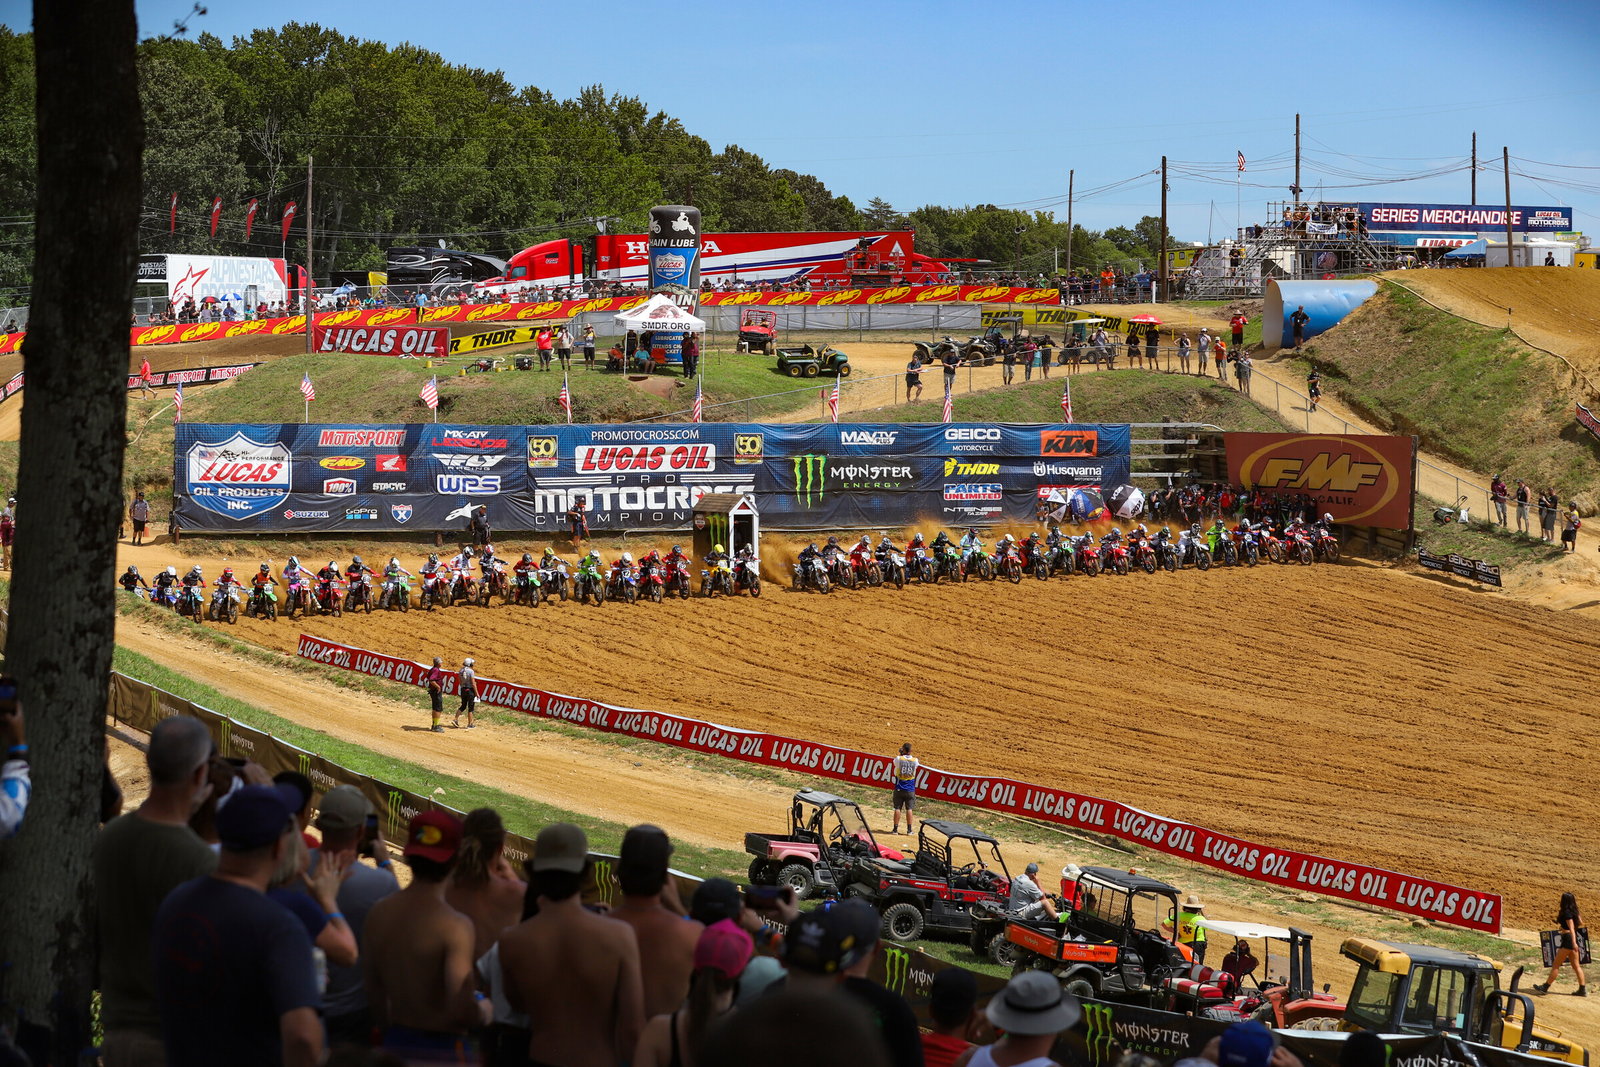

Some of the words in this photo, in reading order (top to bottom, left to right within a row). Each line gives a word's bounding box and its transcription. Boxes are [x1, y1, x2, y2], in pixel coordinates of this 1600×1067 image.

[1371, 208, 1418, 223] SERIES
[1421, 209, 1521, 225] MERCHANDISE
[670, 239, 694, 247] LUBE
[211, 259, 275, 283] ALPINESTARS
[719, 292, 761, 305] FMF
[768, 292, 811, 305] FMF
[817, 290, 861, 305] FMF
[867, 287, 911, 304] FMF
[916, 285, 959, 302] FMF
[965, 287, 1010, 302] FMF
[1015, 289, 1057, 304] FMF
[467, 304, 511, 320] FMF
[517, 302, 562, 319] FMF
[568, 298, 612, 316] FMF
[319, 310, 361, 326] FMF
[367, 308, 411, 325] FMF
[1037, 310, 1078, 323] THOR
[181, 322, 220, 341] FMF
[226, 319, 267, 337] FMF
[642, 321, 690, 330] SMDR.ORG
[137, 325, 176, 344] FMF
[321, 328, 397, 353] LUCAS
[401, 329, 438, 354] OIL
[472, 329, 516, 348] THOR
[445, 429, 488, 438] MX-ATV
[591, 430, 699, 441] PROMOTOCROSS.COM
[945, 428, 1002, 440] GEICO
[531, 438, 555, 457] 50
[737, 435, 761, 454] 50
[1043, 435, 1095, 453] KTM
[320, 457, 365, 469] FMF
[581, 447, 666, 471] LUCAS
[670, 446, 710, 469] OIL
[199, 462, 282, 482] LUCAS
[831, 464, 913, 480] MONSTER
[957, 463, 1000, 475] THOR
[1047, 465, 1102, 476] Husqvarna
[1258, 452, 1383, 492] FMF
[328, 483, 352, 493] 100%
[373, 482, 406, 491] STACYC
[438, 475, 500, 495] WPS
[617, 475, 675, 484] PRO
[194, 487, 214, 496] OIL
[218, 487, 284, 497] PRODUCTS
[944, 484, 1002, 493] PARTS
[227, 501, 253, 510] INC.
[1318, 494, 1356, 506] CALIF.
[294, 510, 329, 518] SUZUKI
[535, 512, 684, 525] CHMPION
[297, 639, 335, 664] LUCAS
[333, 649, 351, 669] OIL
[355, 653, 394, 679] LUCAS
[395, 663, 414, 684] OIL
[480, 684, 523, 708] LUCAS
[522, 692, 541, 713] OIL
[546, 698, 588, 723] LUCAS
[589, 705, 610, 727] OIL
[613, 712, 660, 737] LUCAS
[661, 718, 684, 742] OIL
[230, 733, 255, 752] MONSTER
[689, 725, 739, 753] LUCAS
[739, 736, 764, 758] OIL
[770, 740, 821, 769] LUCAS
[822, 751, 847, 774] OIL
[310, 767, 336, 788] MONSTER
[936, 775, 990, 802] LUCAS
[990, 782, 1017, 806] OIL
[1023, 789, 1075, 820] LUCAS
[1078, 800, 1105, 826] OIL
[1112, 808, 1169, 844] LUCAS
[1167, 826, 1197, 854] OIL
[1201, 836, 1261, 872] LUCAS
[1261, 852, 1292, 879] OIL
[1296, 859, 1358, 893] LUCAS
[1359, 872, 1389, 900] OIL
[1395, 880, 1461, 917] LUCAS
[1461, 896, 1495, 925] OIL
[1115, 1021, 1190, 1048] MONSTER
[1126, 1041, 1179, 1057] ENERGY
